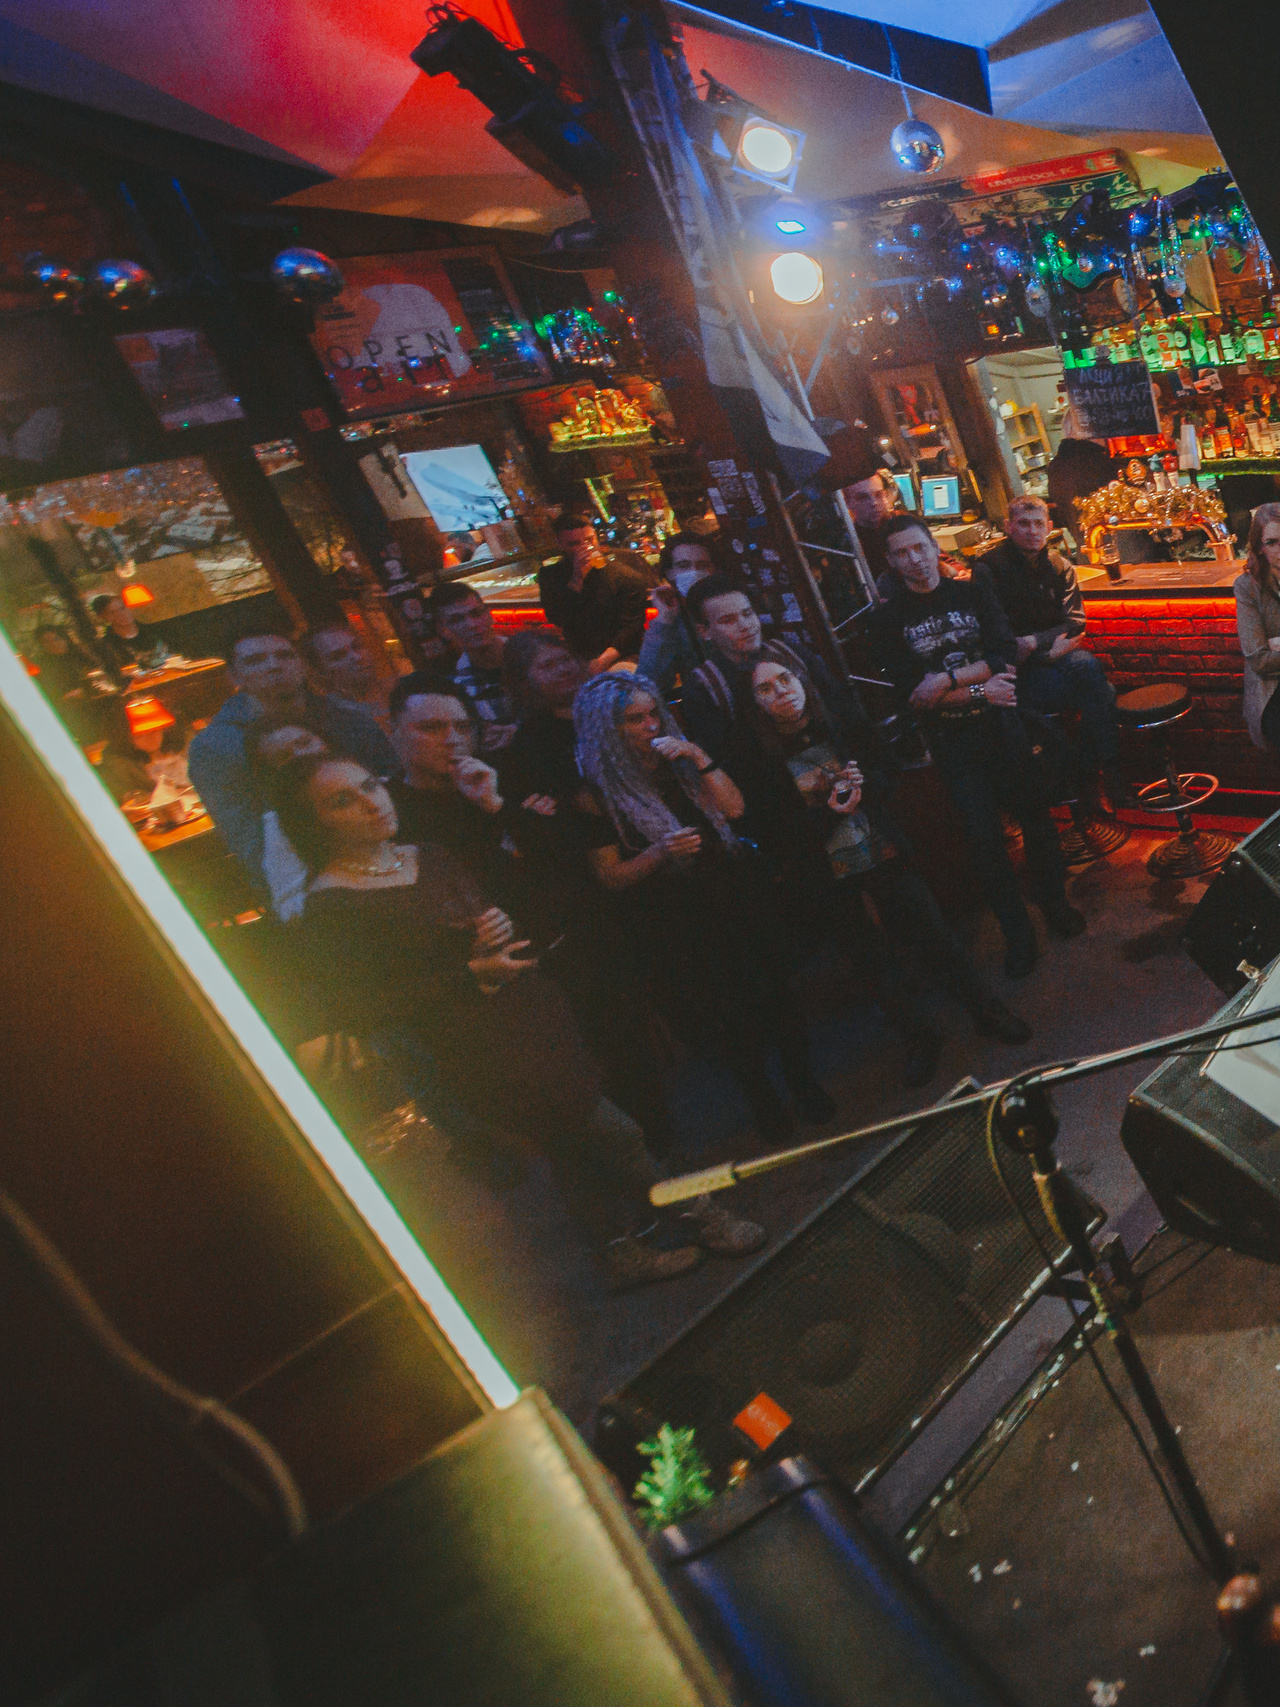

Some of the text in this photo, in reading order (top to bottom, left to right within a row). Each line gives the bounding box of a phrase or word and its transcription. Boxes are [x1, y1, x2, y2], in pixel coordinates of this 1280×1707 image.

[987, 170, 1055, 188] LIVERPOOL
[1070, 181, 1095, 195] FC
[327, 329, 453, 370] OPEN
